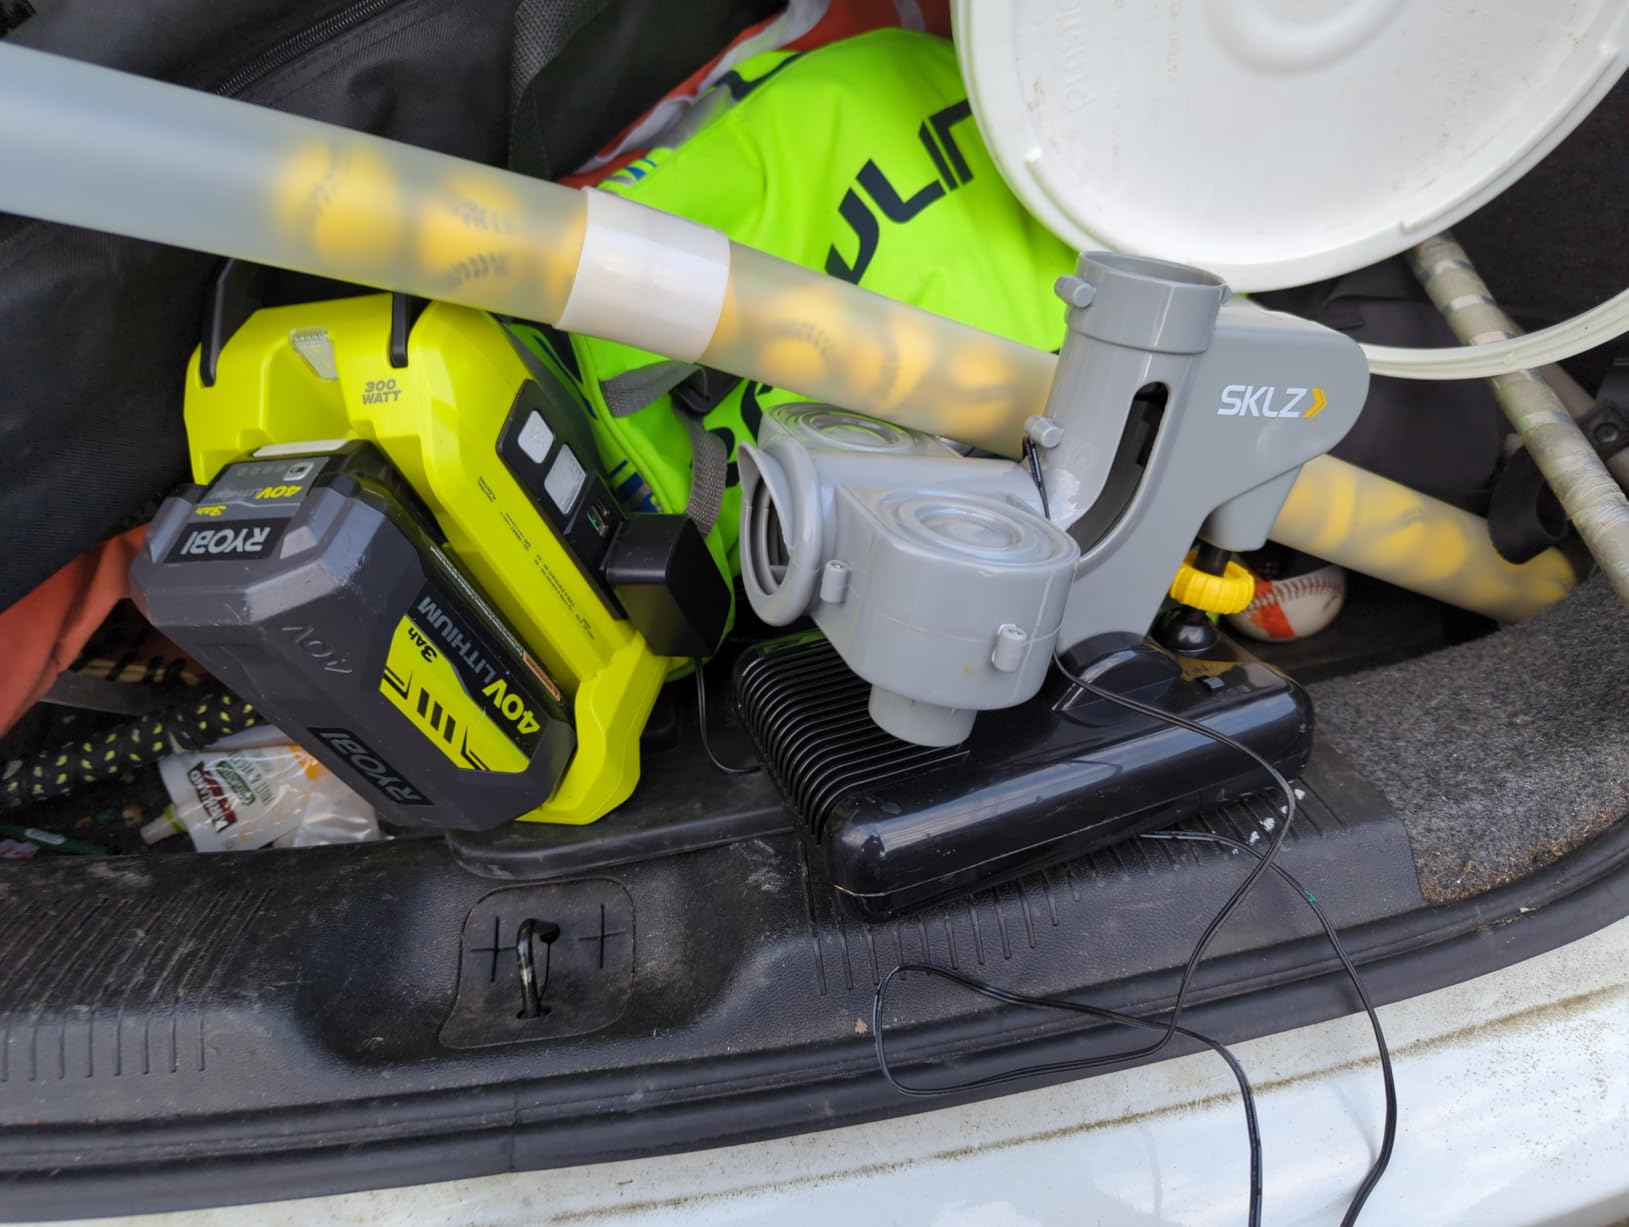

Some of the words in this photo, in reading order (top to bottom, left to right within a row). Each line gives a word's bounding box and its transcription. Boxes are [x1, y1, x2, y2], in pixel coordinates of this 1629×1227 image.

[362, 390, 402, 405] WATT
[365, 379, 396, 392] 300
[1217, 384, 1308, 418] SKLZ
[255, 485, 303, 499] 40V
[180, 526, 271, 555] RYOBI
[408, 627, 438, 663] 3Ah
[417, 596, 497, 684] LITHIUM
[482, 678, 541, 735] 40V
[320, 733, 423, 800] RYOBI
